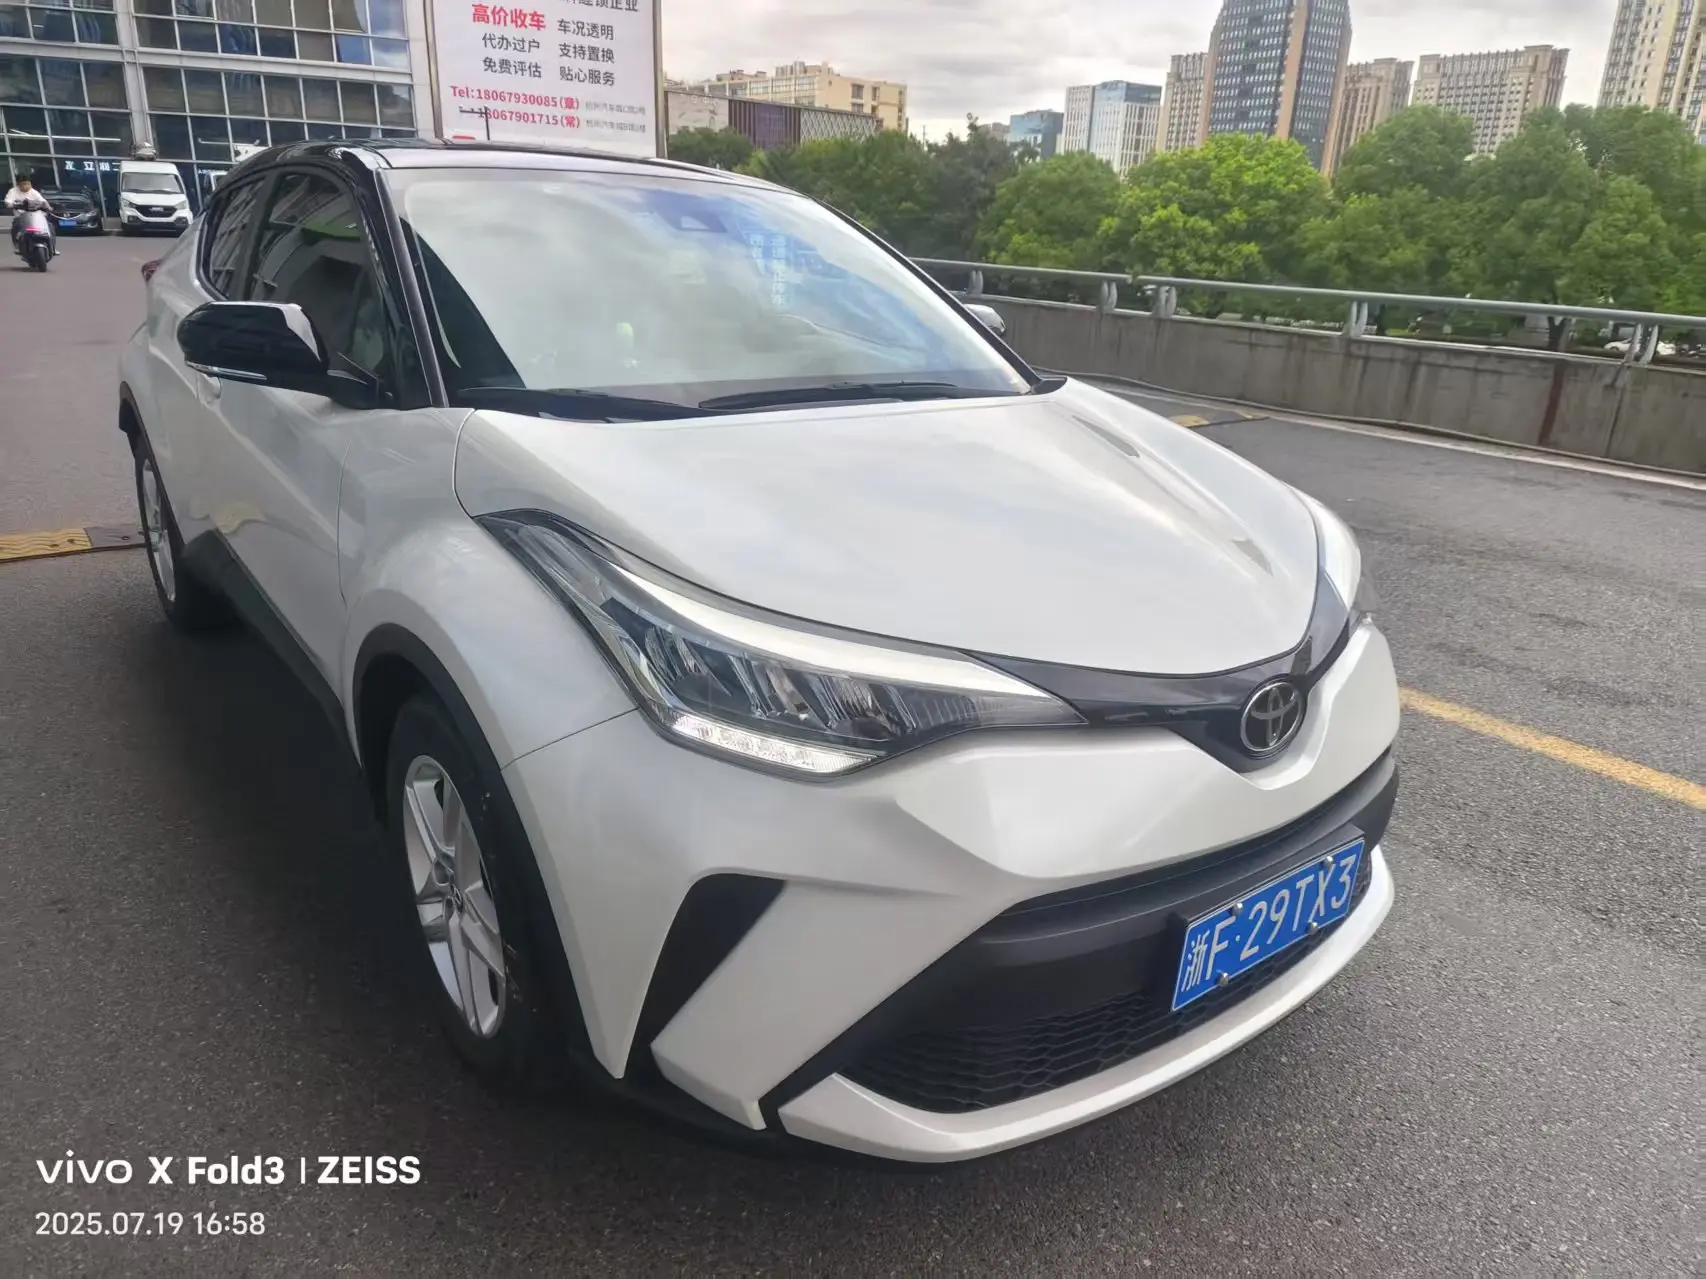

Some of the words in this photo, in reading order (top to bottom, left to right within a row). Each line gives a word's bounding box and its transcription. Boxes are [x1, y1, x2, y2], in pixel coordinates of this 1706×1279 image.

[472, 3, 546, 31] 高价收车
[557, 18, 615, 41] 车况透明
[482, 33, 541, 54] 代办过户
[558, 43, 616, 64] 支持置换
[482, 56, 543, 79] 免费评估
[559, 66, 616, 87] 贴心服务
